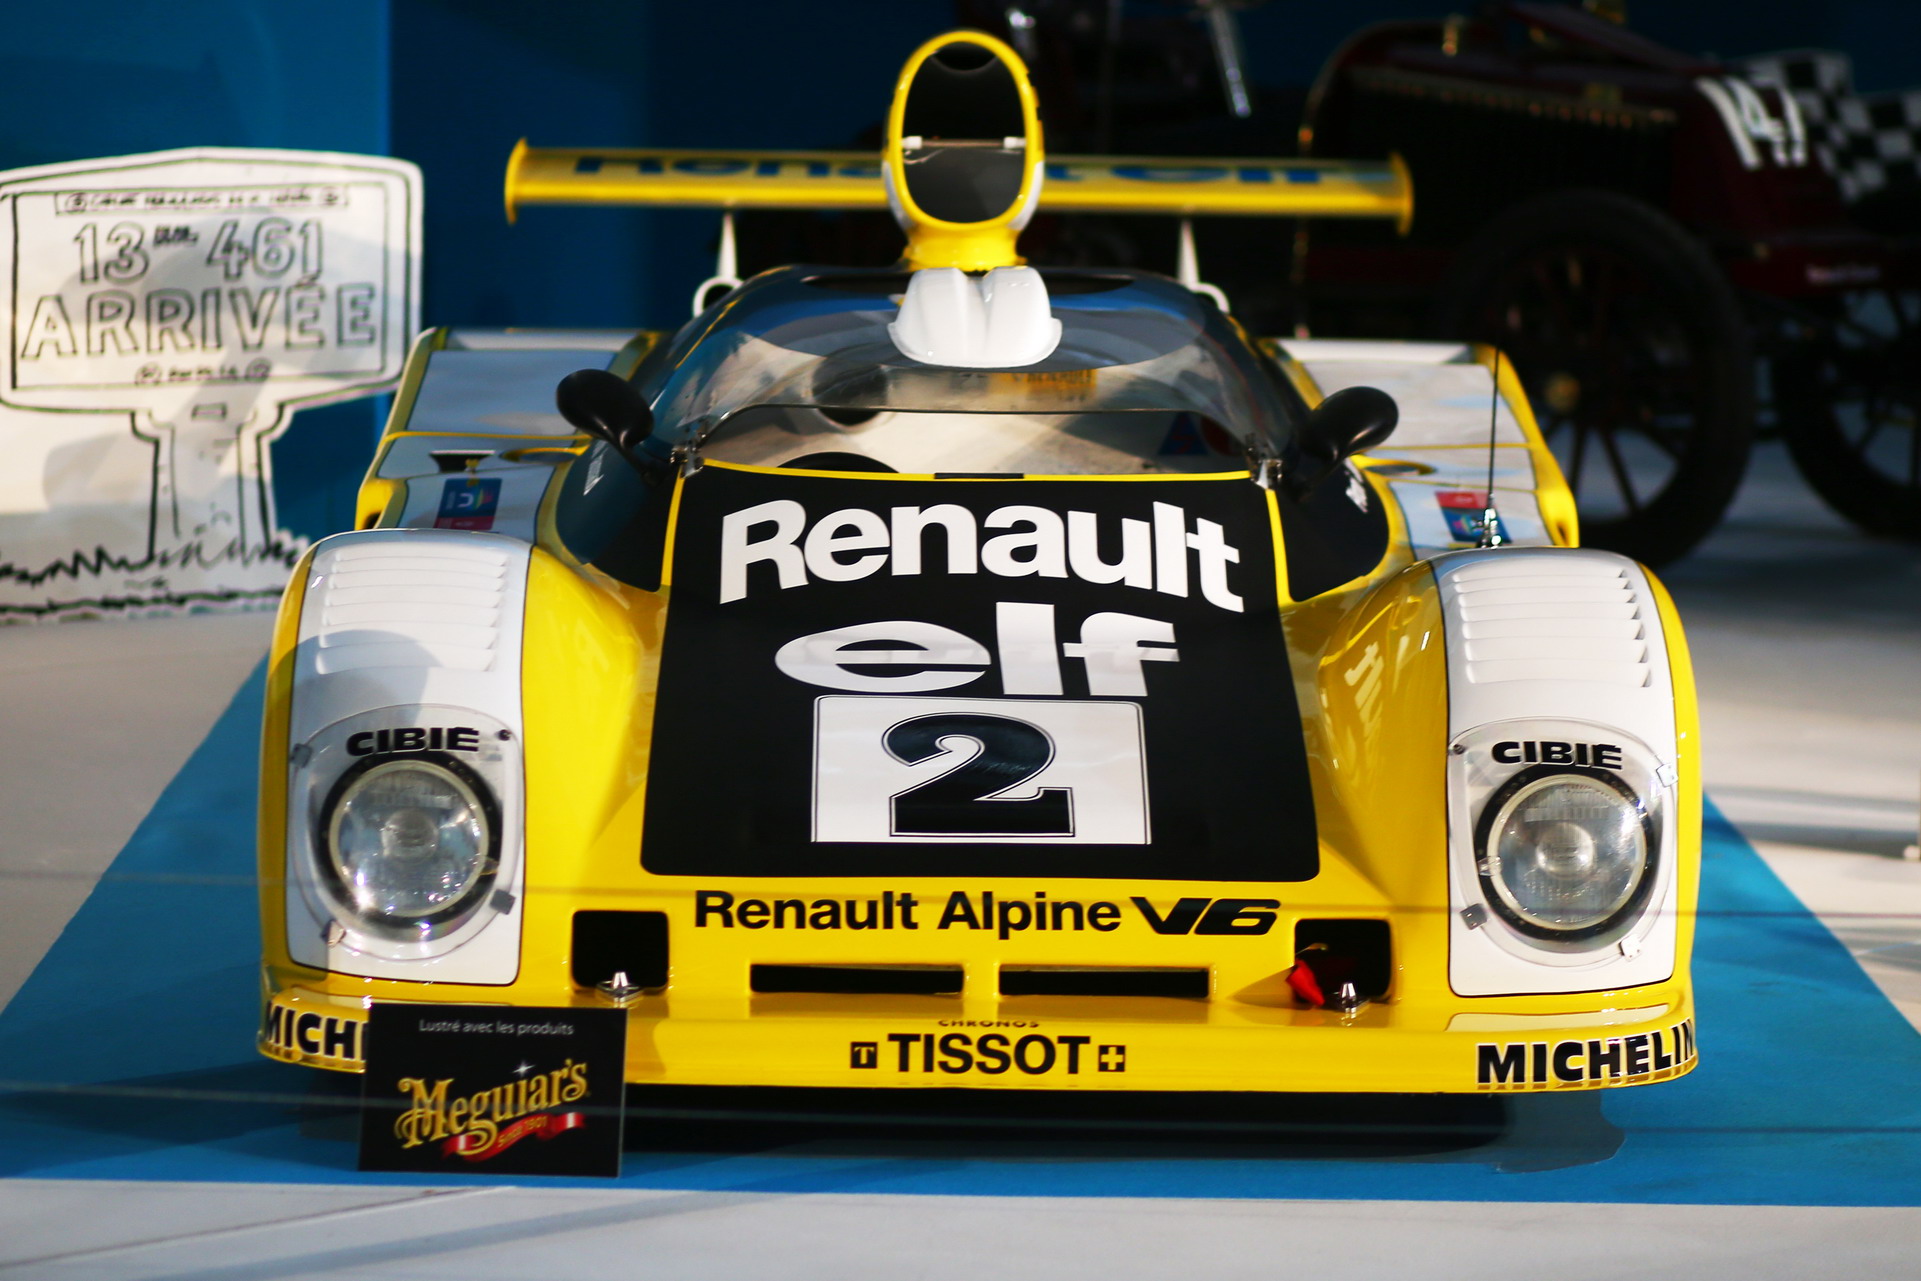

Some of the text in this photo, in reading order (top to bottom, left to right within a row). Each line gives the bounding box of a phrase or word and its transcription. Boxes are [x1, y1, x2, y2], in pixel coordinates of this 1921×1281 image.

[74, 217, 323, 284] 13 461
[20, 277, 376, 359] ARRIVÉE
[720, 499, 1244, 613] Renault
[774, 601, 1180, 697] elf
[881, 711, 1076, 838] 2
[693, 889, 1281, 941] Renault Alpine V6
[418, 1018, 575, 1038] Lustré avec les produits
[887, 1032, 1091, 1075] TISSOT
[1476, 1017, 1694, 1084] MICHELIN
[395, 1058, 588, 1156] Meguiar's
